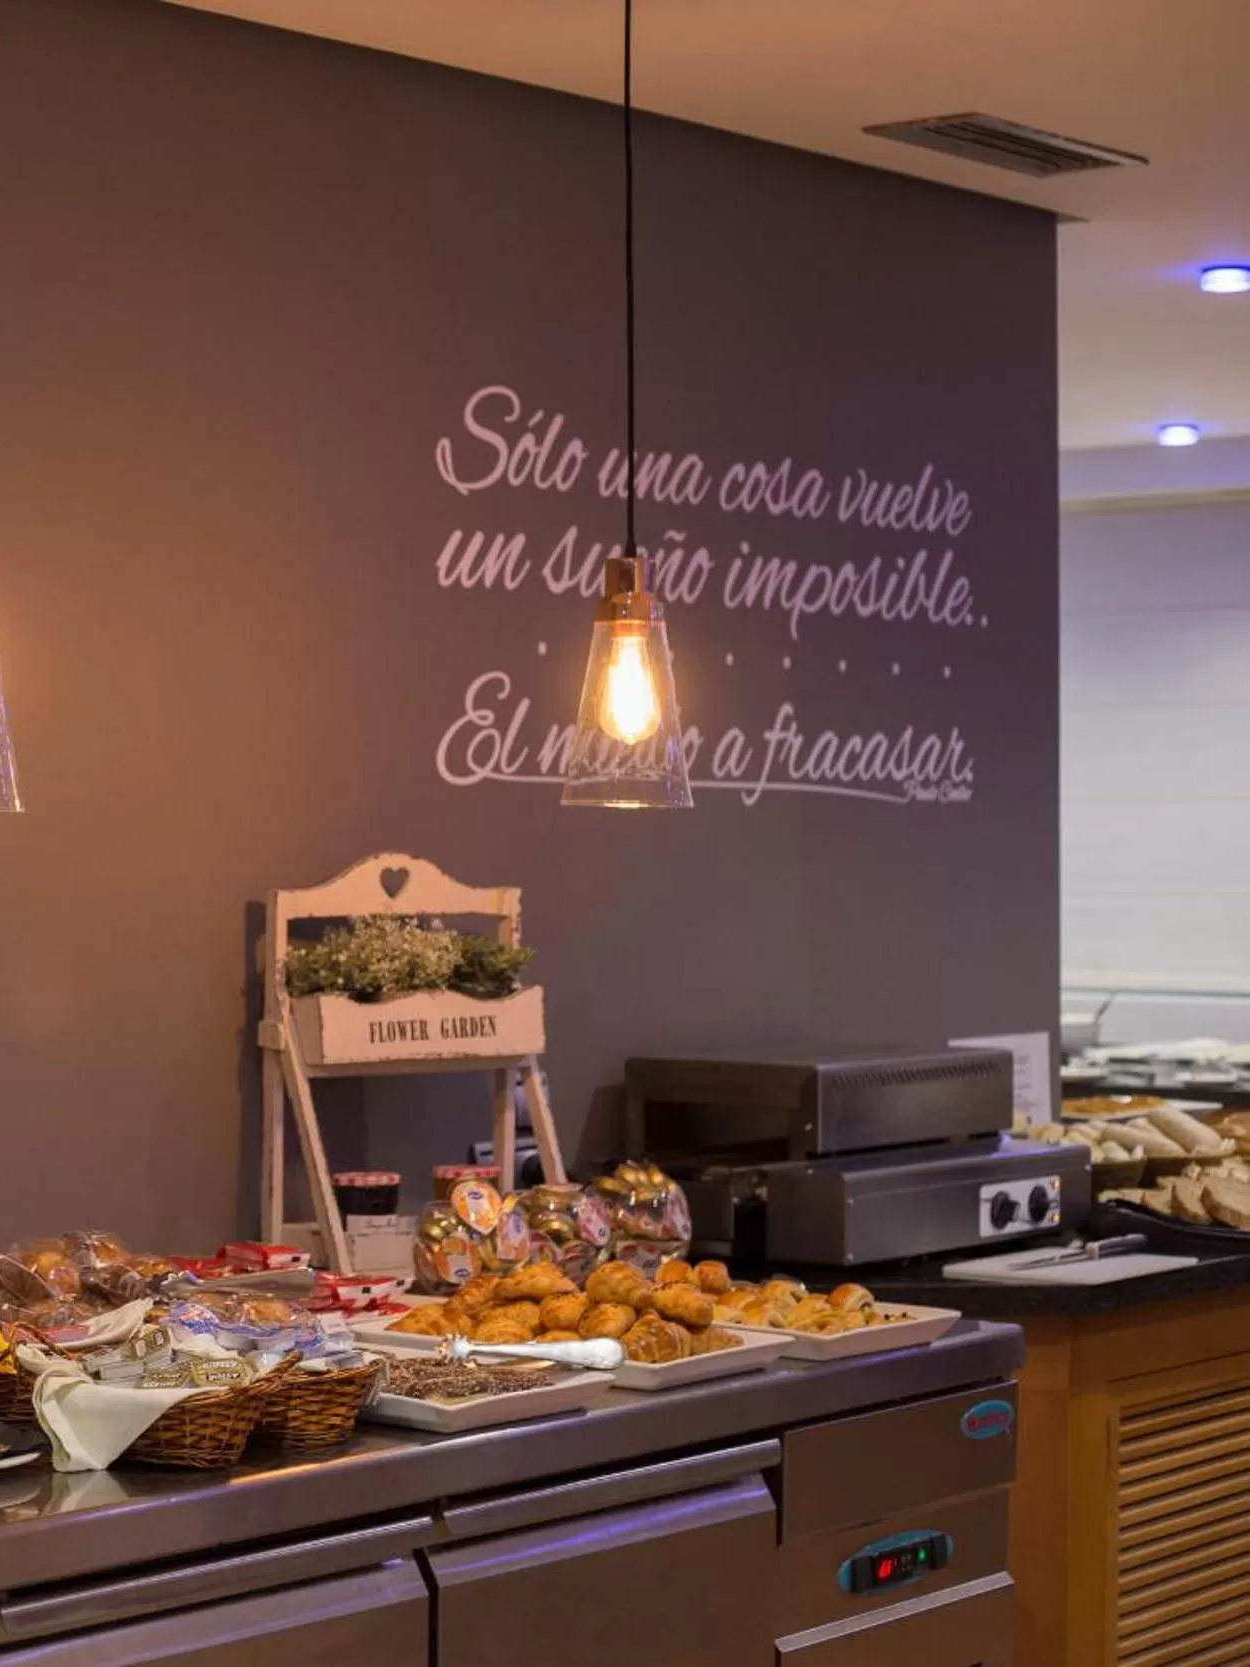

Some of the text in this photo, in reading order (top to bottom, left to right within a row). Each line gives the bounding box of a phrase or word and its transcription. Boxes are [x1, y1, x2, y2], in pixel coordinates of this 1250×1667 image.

[436, 386, 972, 537] Sólo una cosa vuelve
[436, 529, 531, 590] un
[437, 671, 531, 786] El
[712, 727, 753, 778] a
[369, 1015, 496, 1044] FLOWER GARDEN
